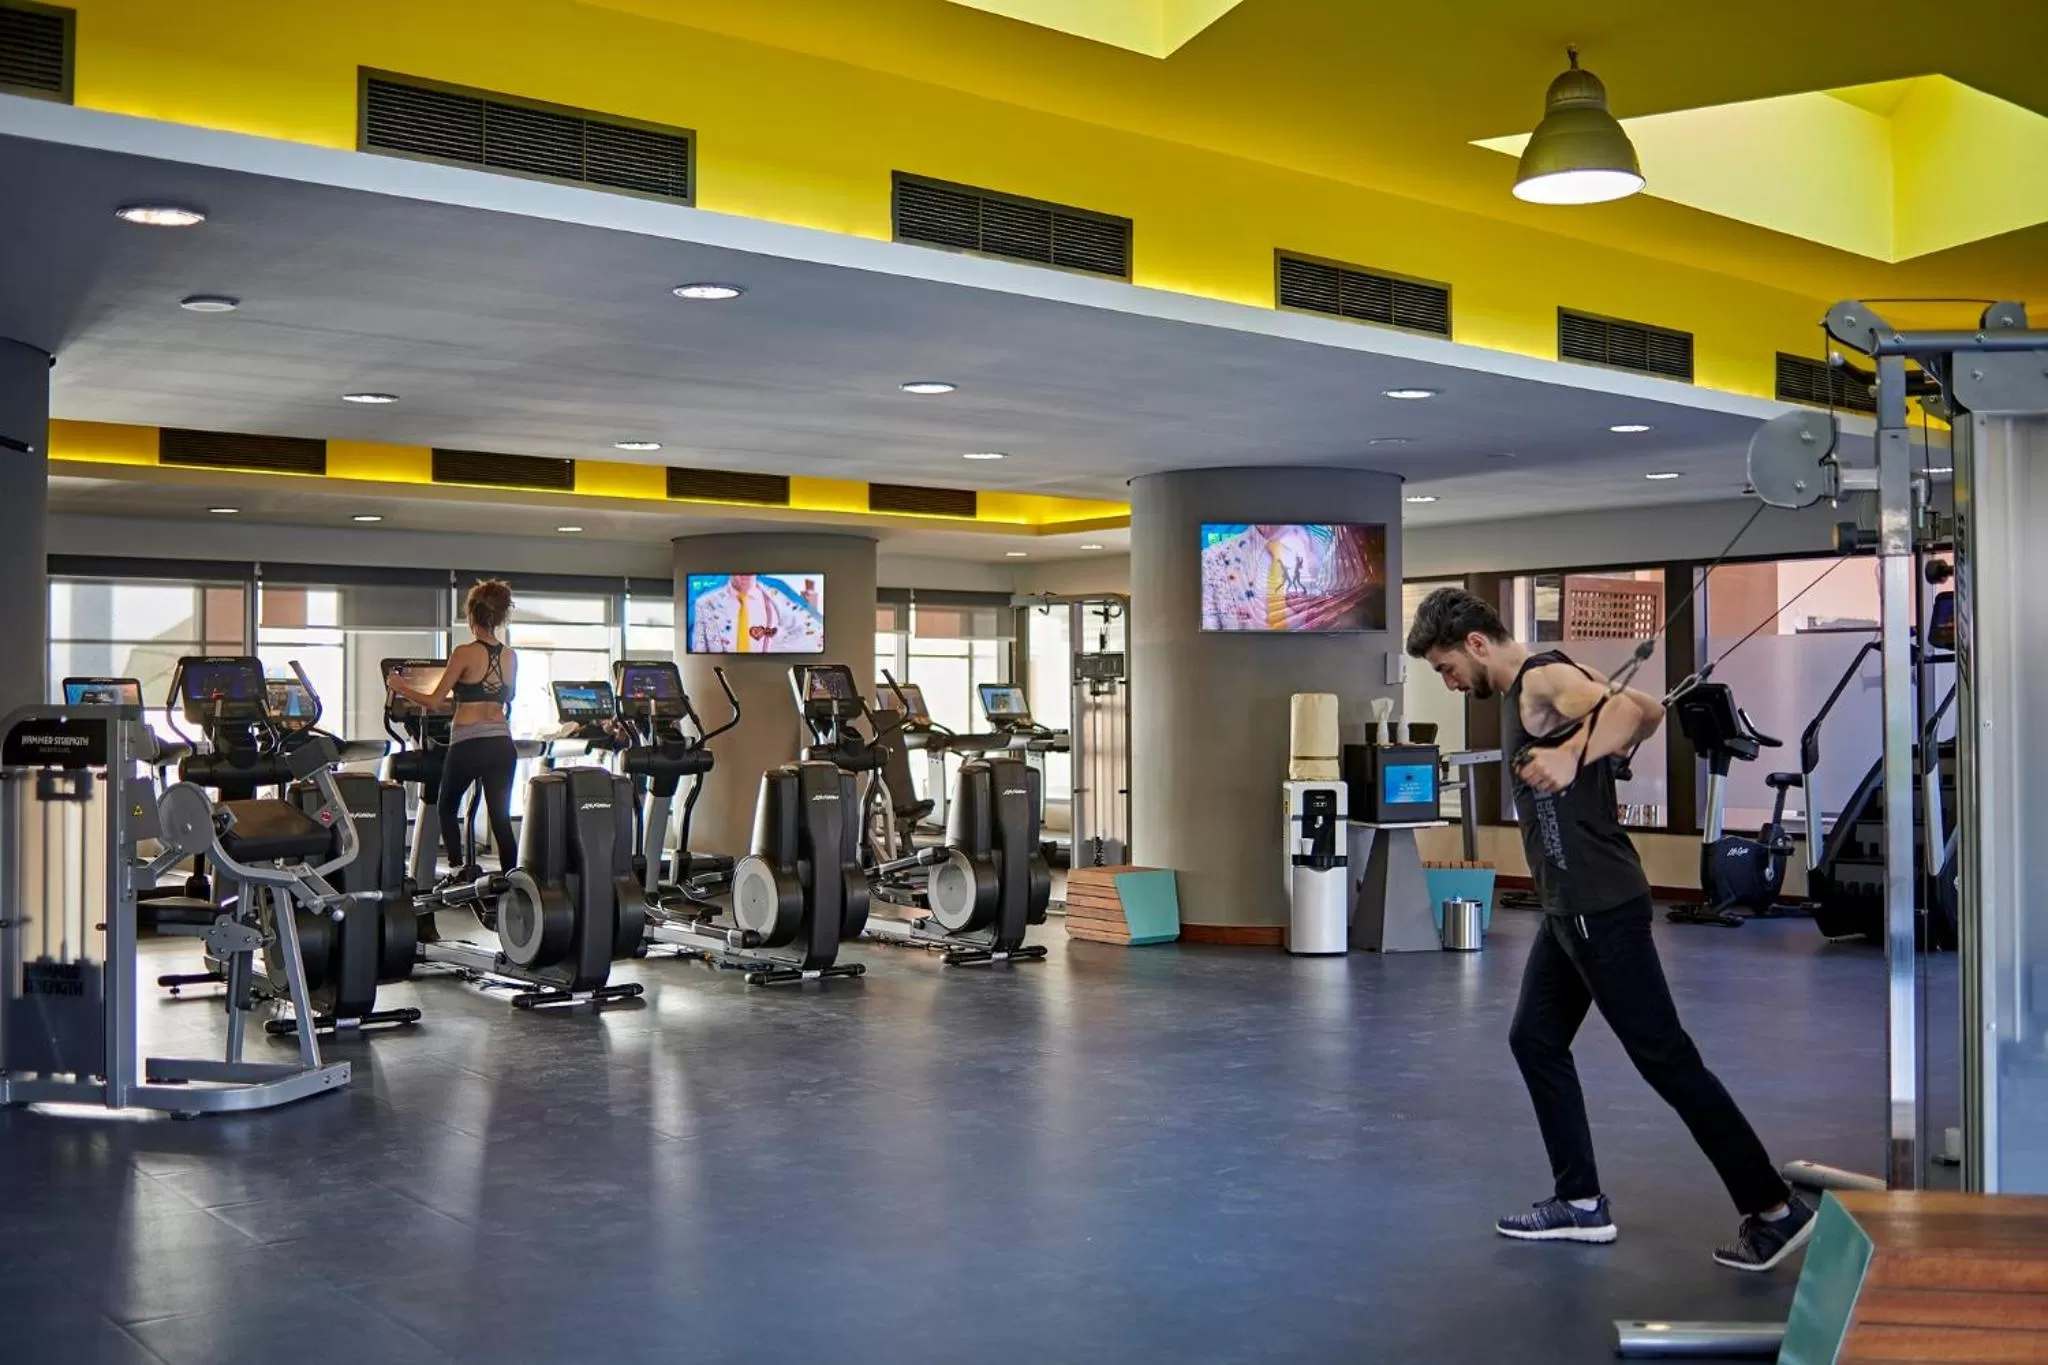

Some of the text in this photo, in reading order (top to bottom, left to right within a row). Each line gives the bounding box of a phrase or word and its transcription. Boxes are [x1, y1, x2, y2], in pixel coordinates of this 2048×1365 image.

[21, 735, 90, 747] HAMMER STRENGTH
[1536, 801, 1554, 857] UNDER
[1545, 799, 1568, 871] ARMOUR
